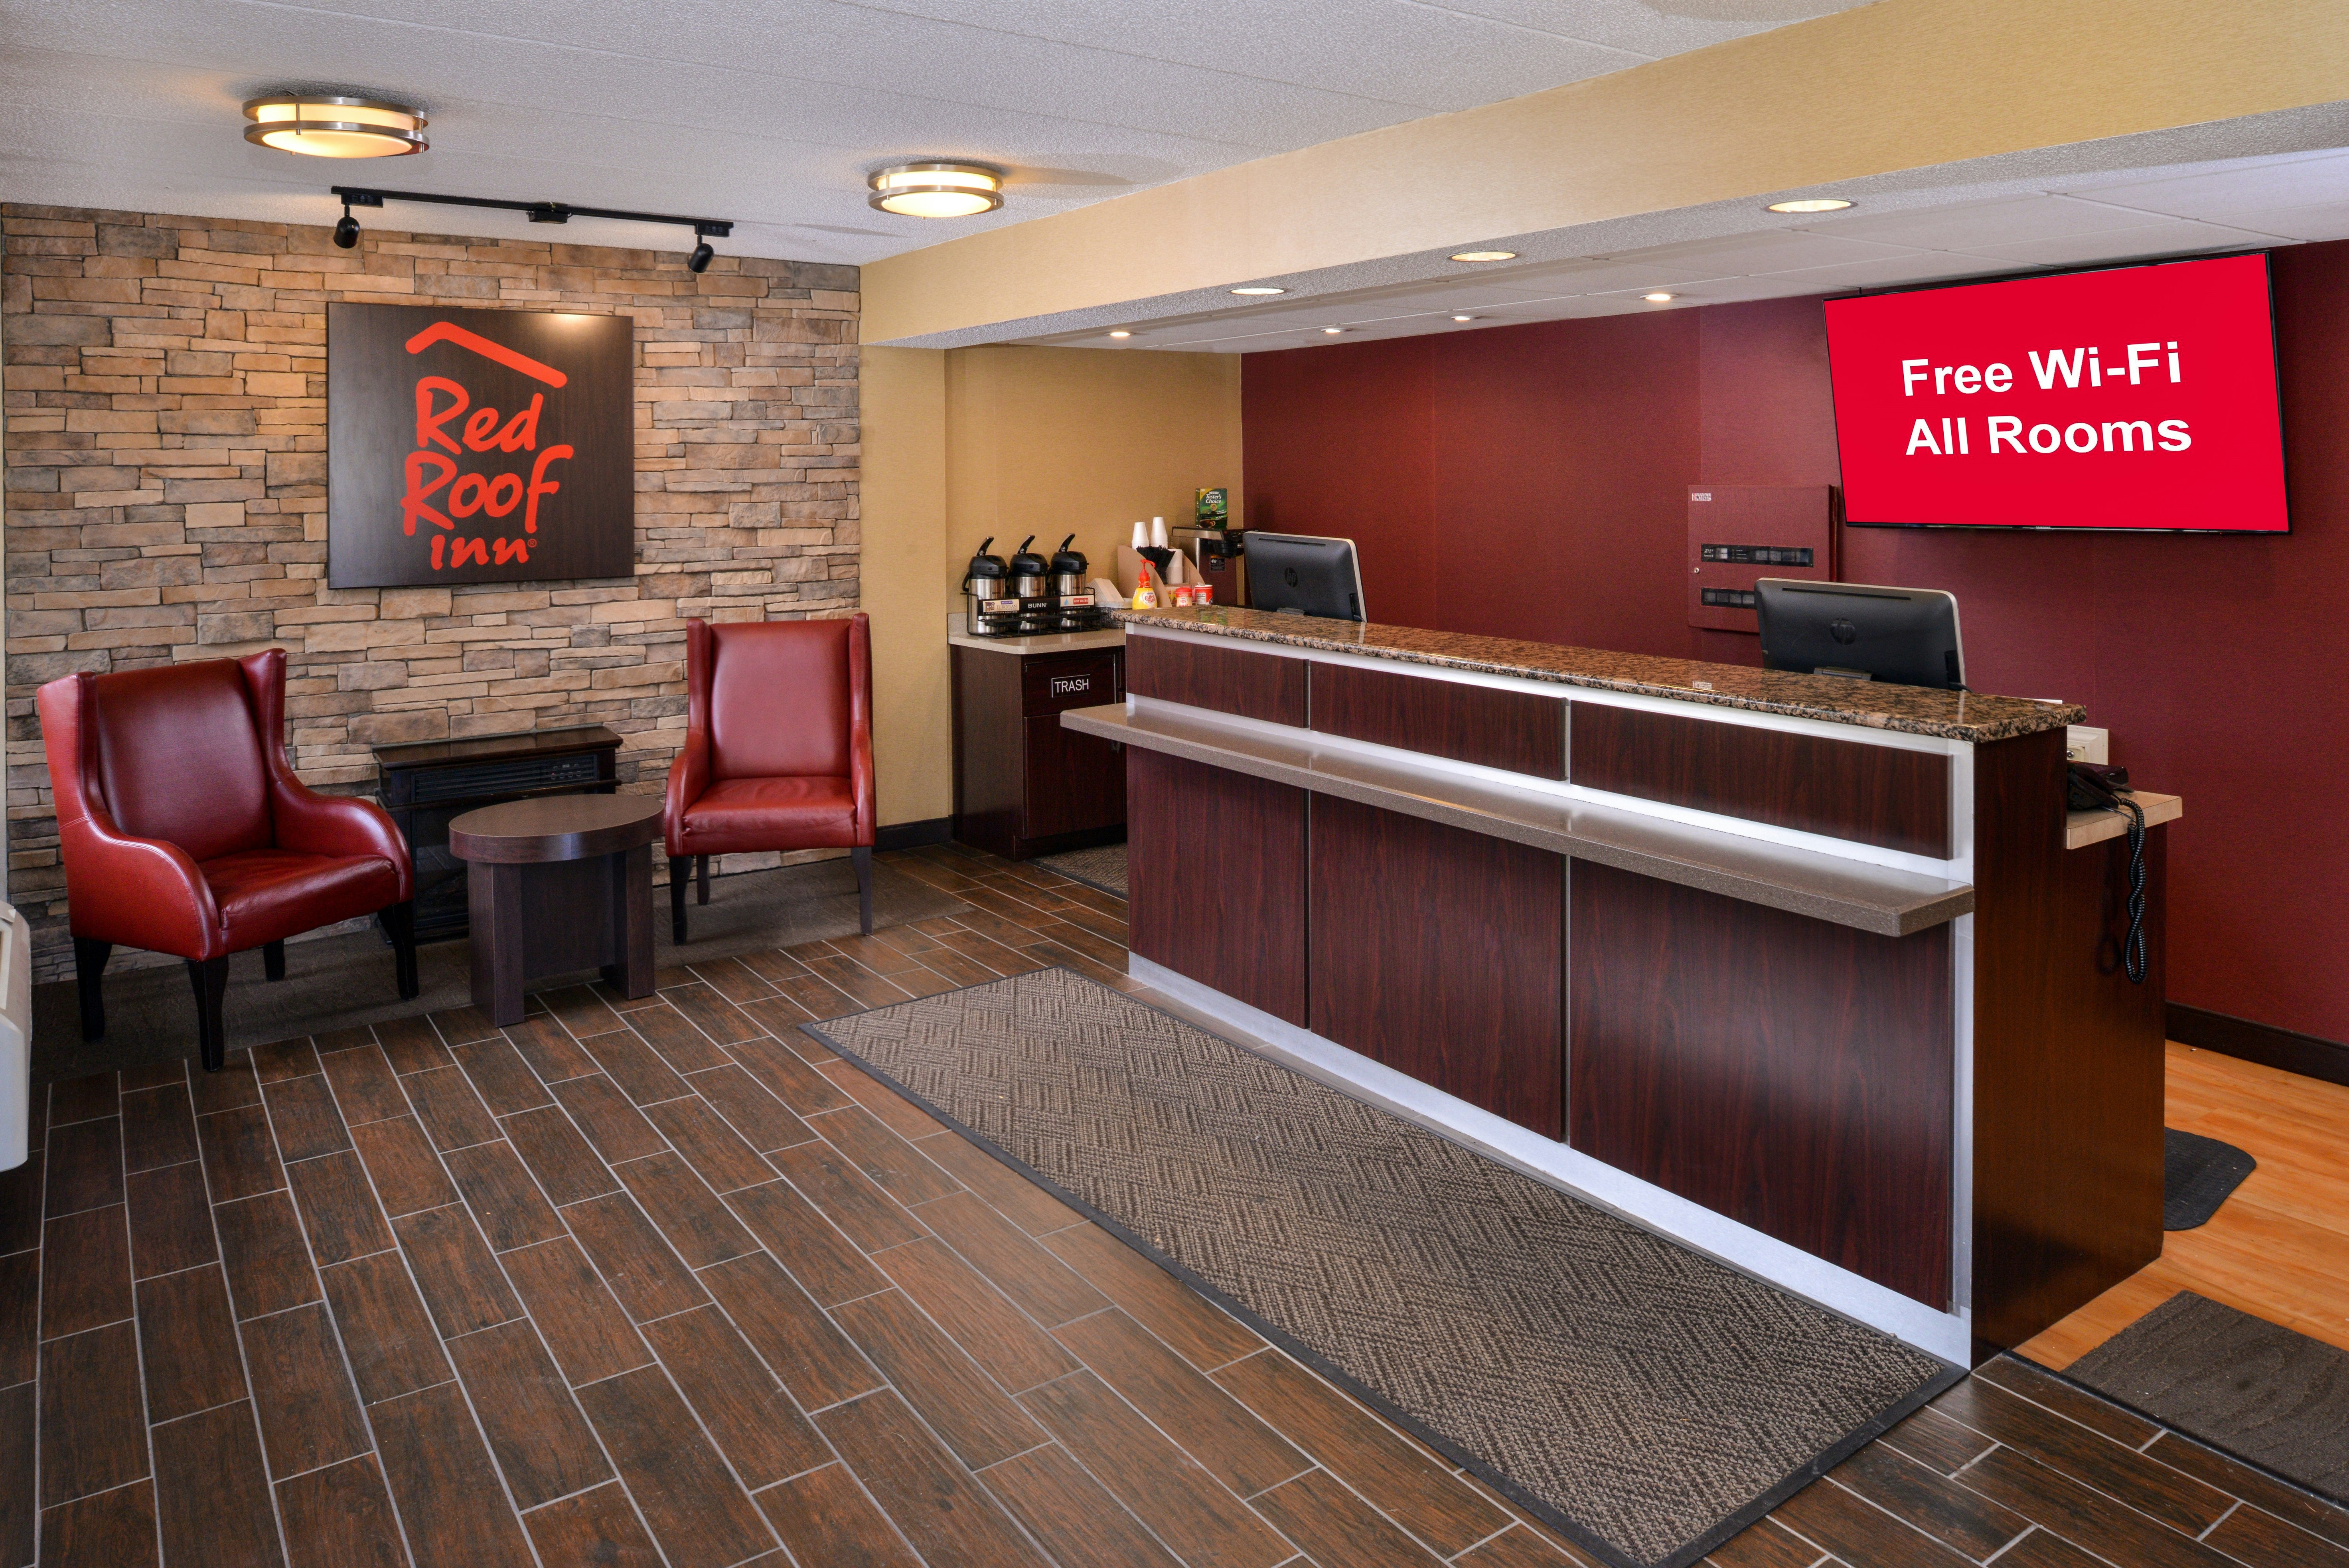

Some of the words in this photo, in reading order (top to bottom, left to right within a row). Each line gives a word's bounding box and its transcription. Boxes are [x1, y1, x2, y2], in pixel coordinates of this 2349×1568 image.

[1902, 358, 2013, 396] Free
[2027, 341, 2181, 389] Wi-Fi
[415, 375, 544, 455] Red
[1905, 417, 1969, 455] All
[1988, 415, 2191, 454] Rooms
[400, 444, 574, 536] Roof
[1054, 678, 1089, 693] TRASH
